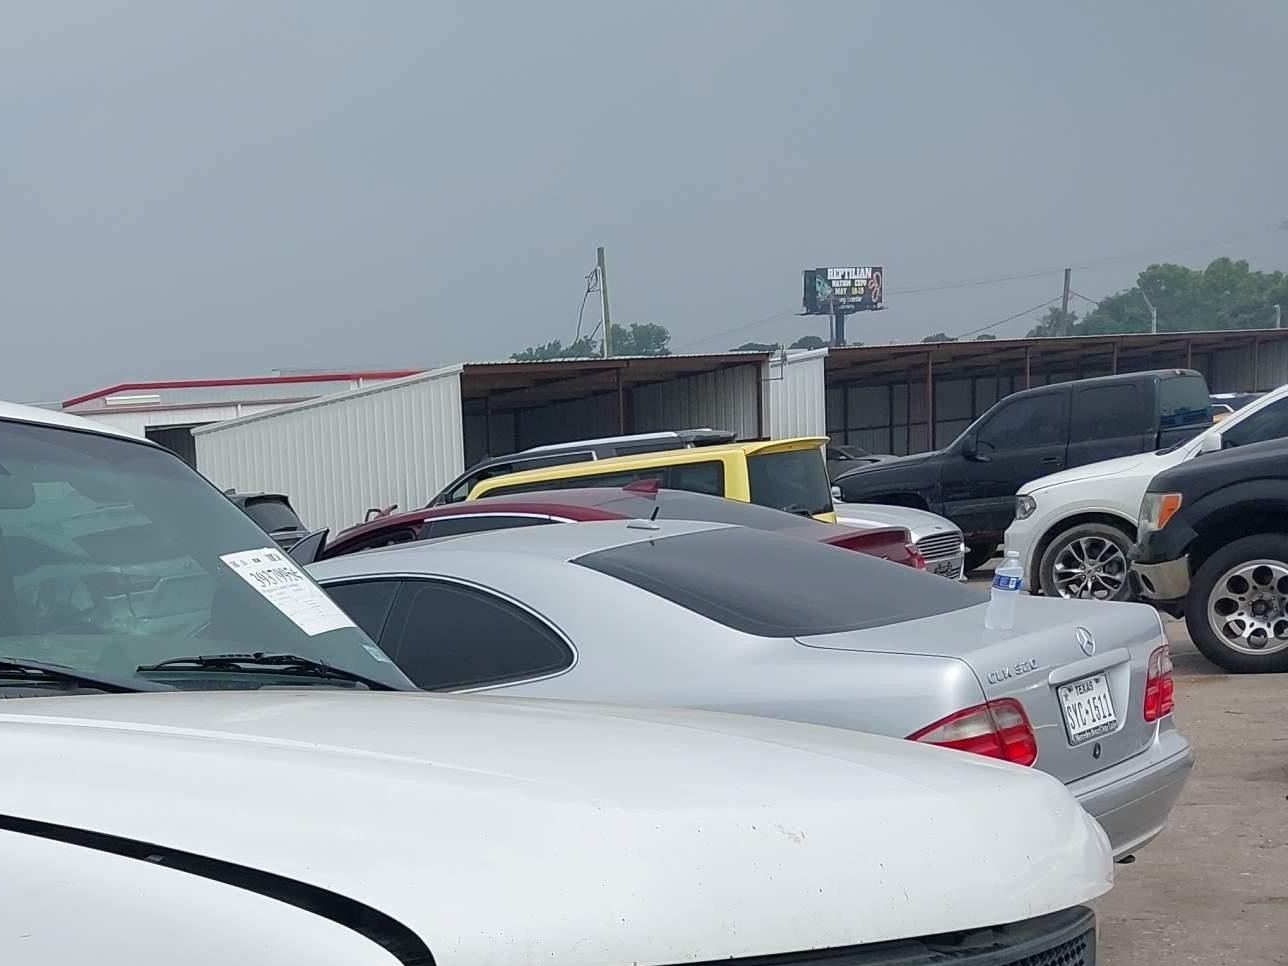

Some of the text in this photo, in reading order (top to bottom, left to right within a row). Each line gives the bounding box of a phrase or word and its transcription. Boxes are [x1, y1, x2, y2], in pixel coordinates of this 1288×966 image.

[827, 268, 872, 280] REPTILIAN
[834, 287, 848, 295] MAY
[987, 659, 1038, 684] CLK 320
[1074, 680, 1094, 696] TEXAS
